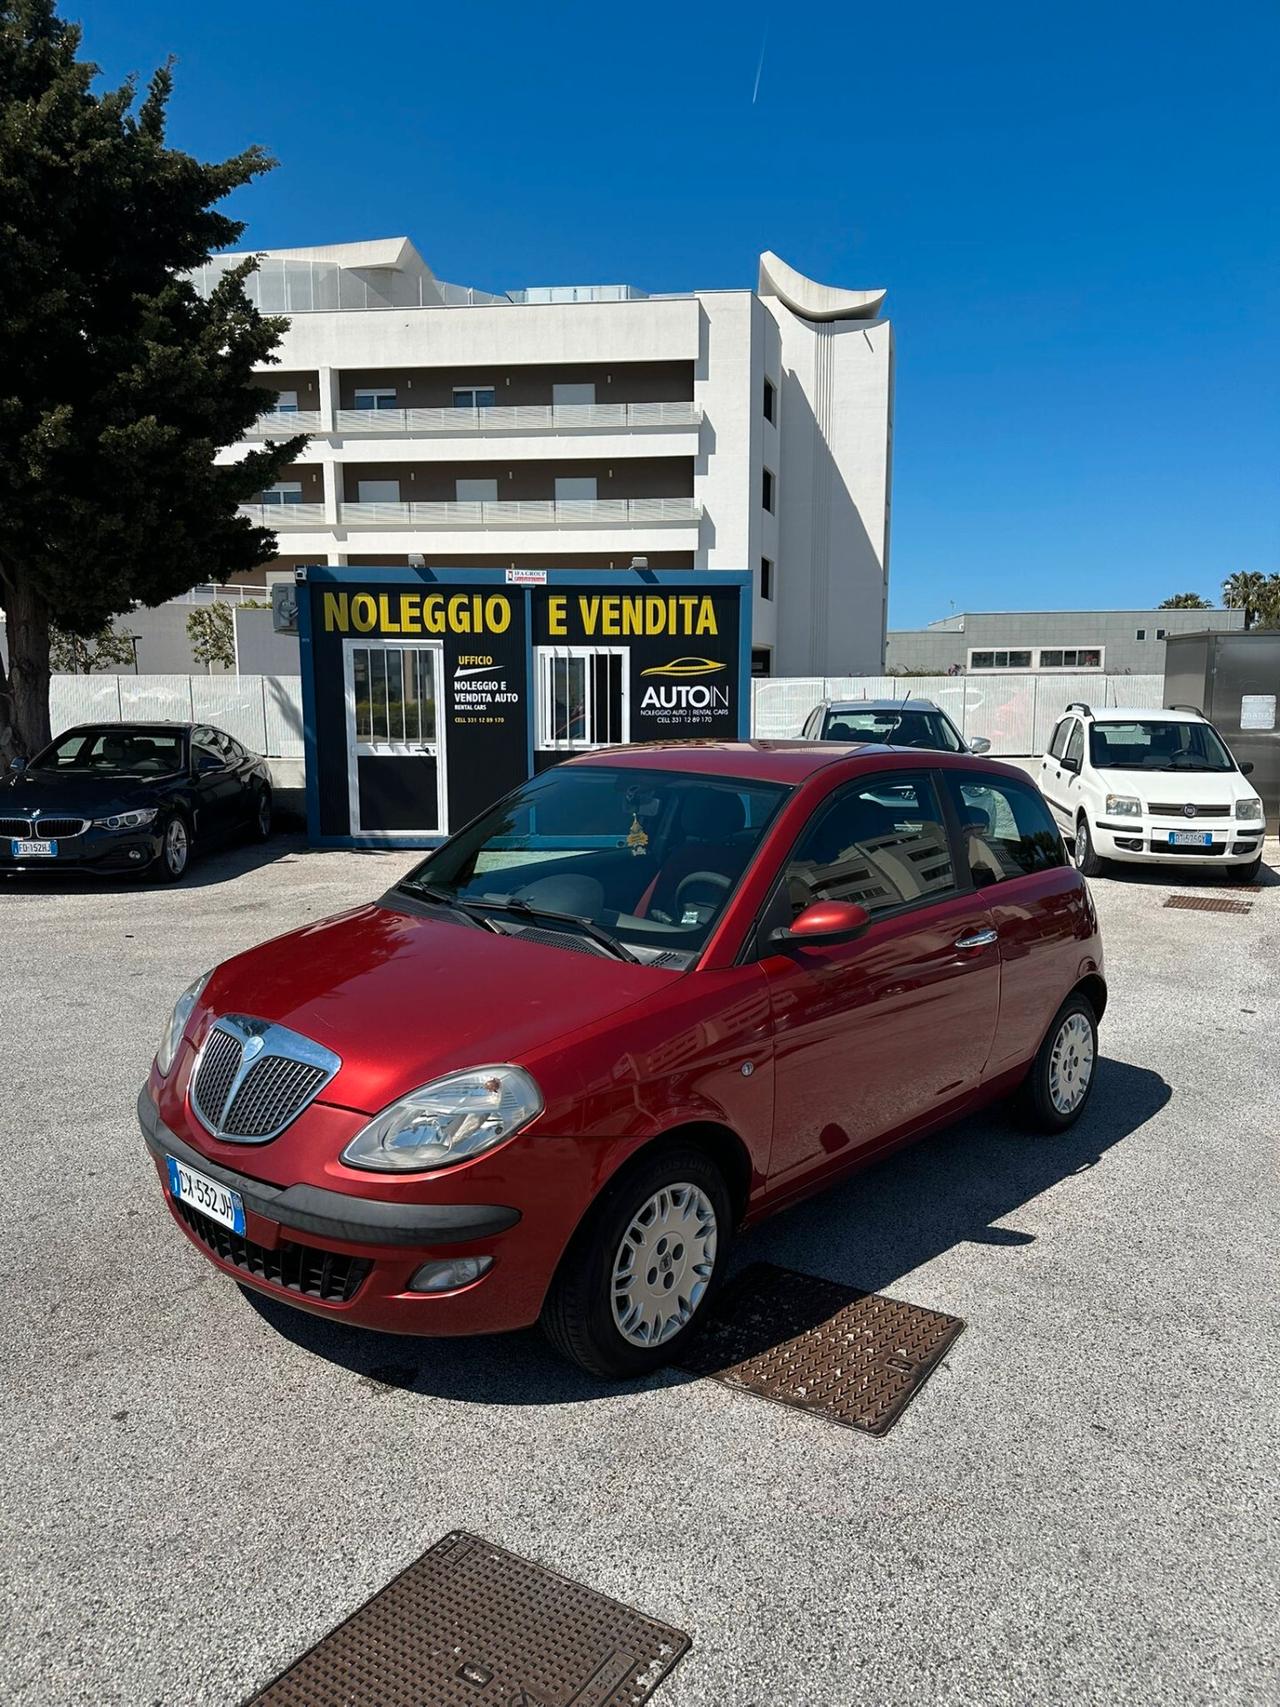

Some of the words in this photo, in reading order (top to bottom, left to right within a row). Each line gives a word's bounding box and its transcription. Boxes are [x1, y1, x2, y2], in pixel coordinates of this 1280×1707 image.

[323, 592, 512, 634] NOLEGGIO
[548, 595, 567, 636] E
[578, 595, 719, 636] VENDITA
[458, 655, 493, 665] UFFICIO
[454, 681, 498, 690] NOLEGGIO
[500, 681, 507, 690] E
[454, 693, 492, 702] VENDITA
[495, 693, 519, 702] AUTO
[640, 685, 729, 708] AUTOIN
